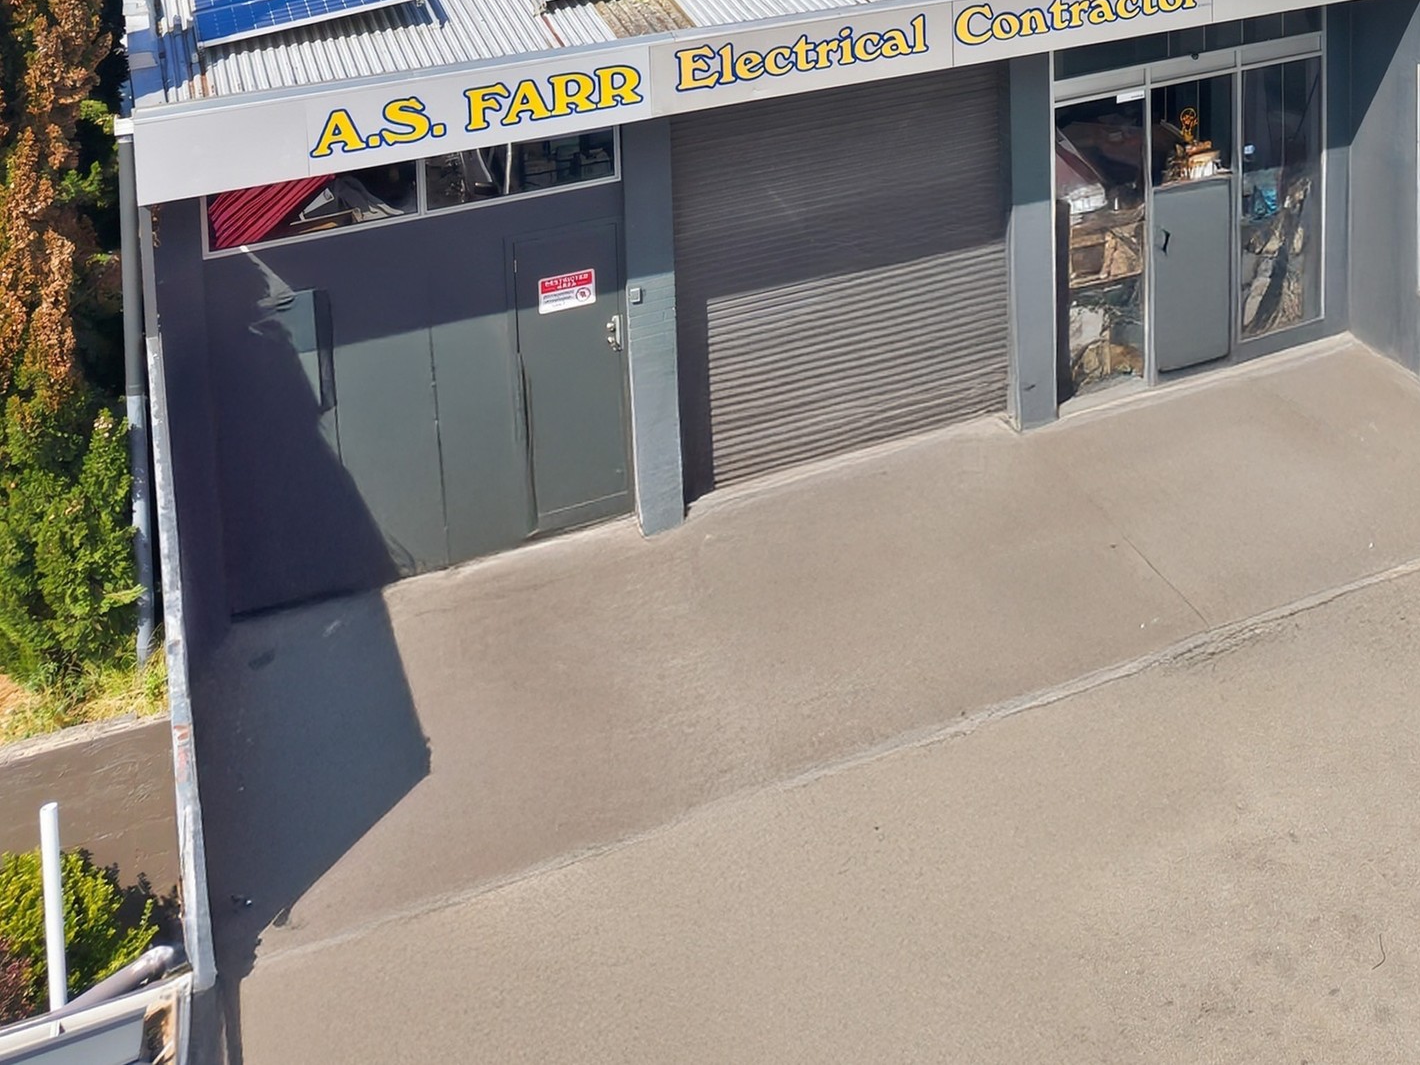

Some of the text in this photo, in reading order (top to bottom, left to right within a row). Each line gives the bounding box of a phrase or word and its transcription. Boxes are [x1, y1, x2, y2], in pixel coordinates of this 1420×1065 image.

[310, 96, 447, 158] A.S.
[463, 64, 643, 132] FARR
[675, 13, 929, 92] Electrical
